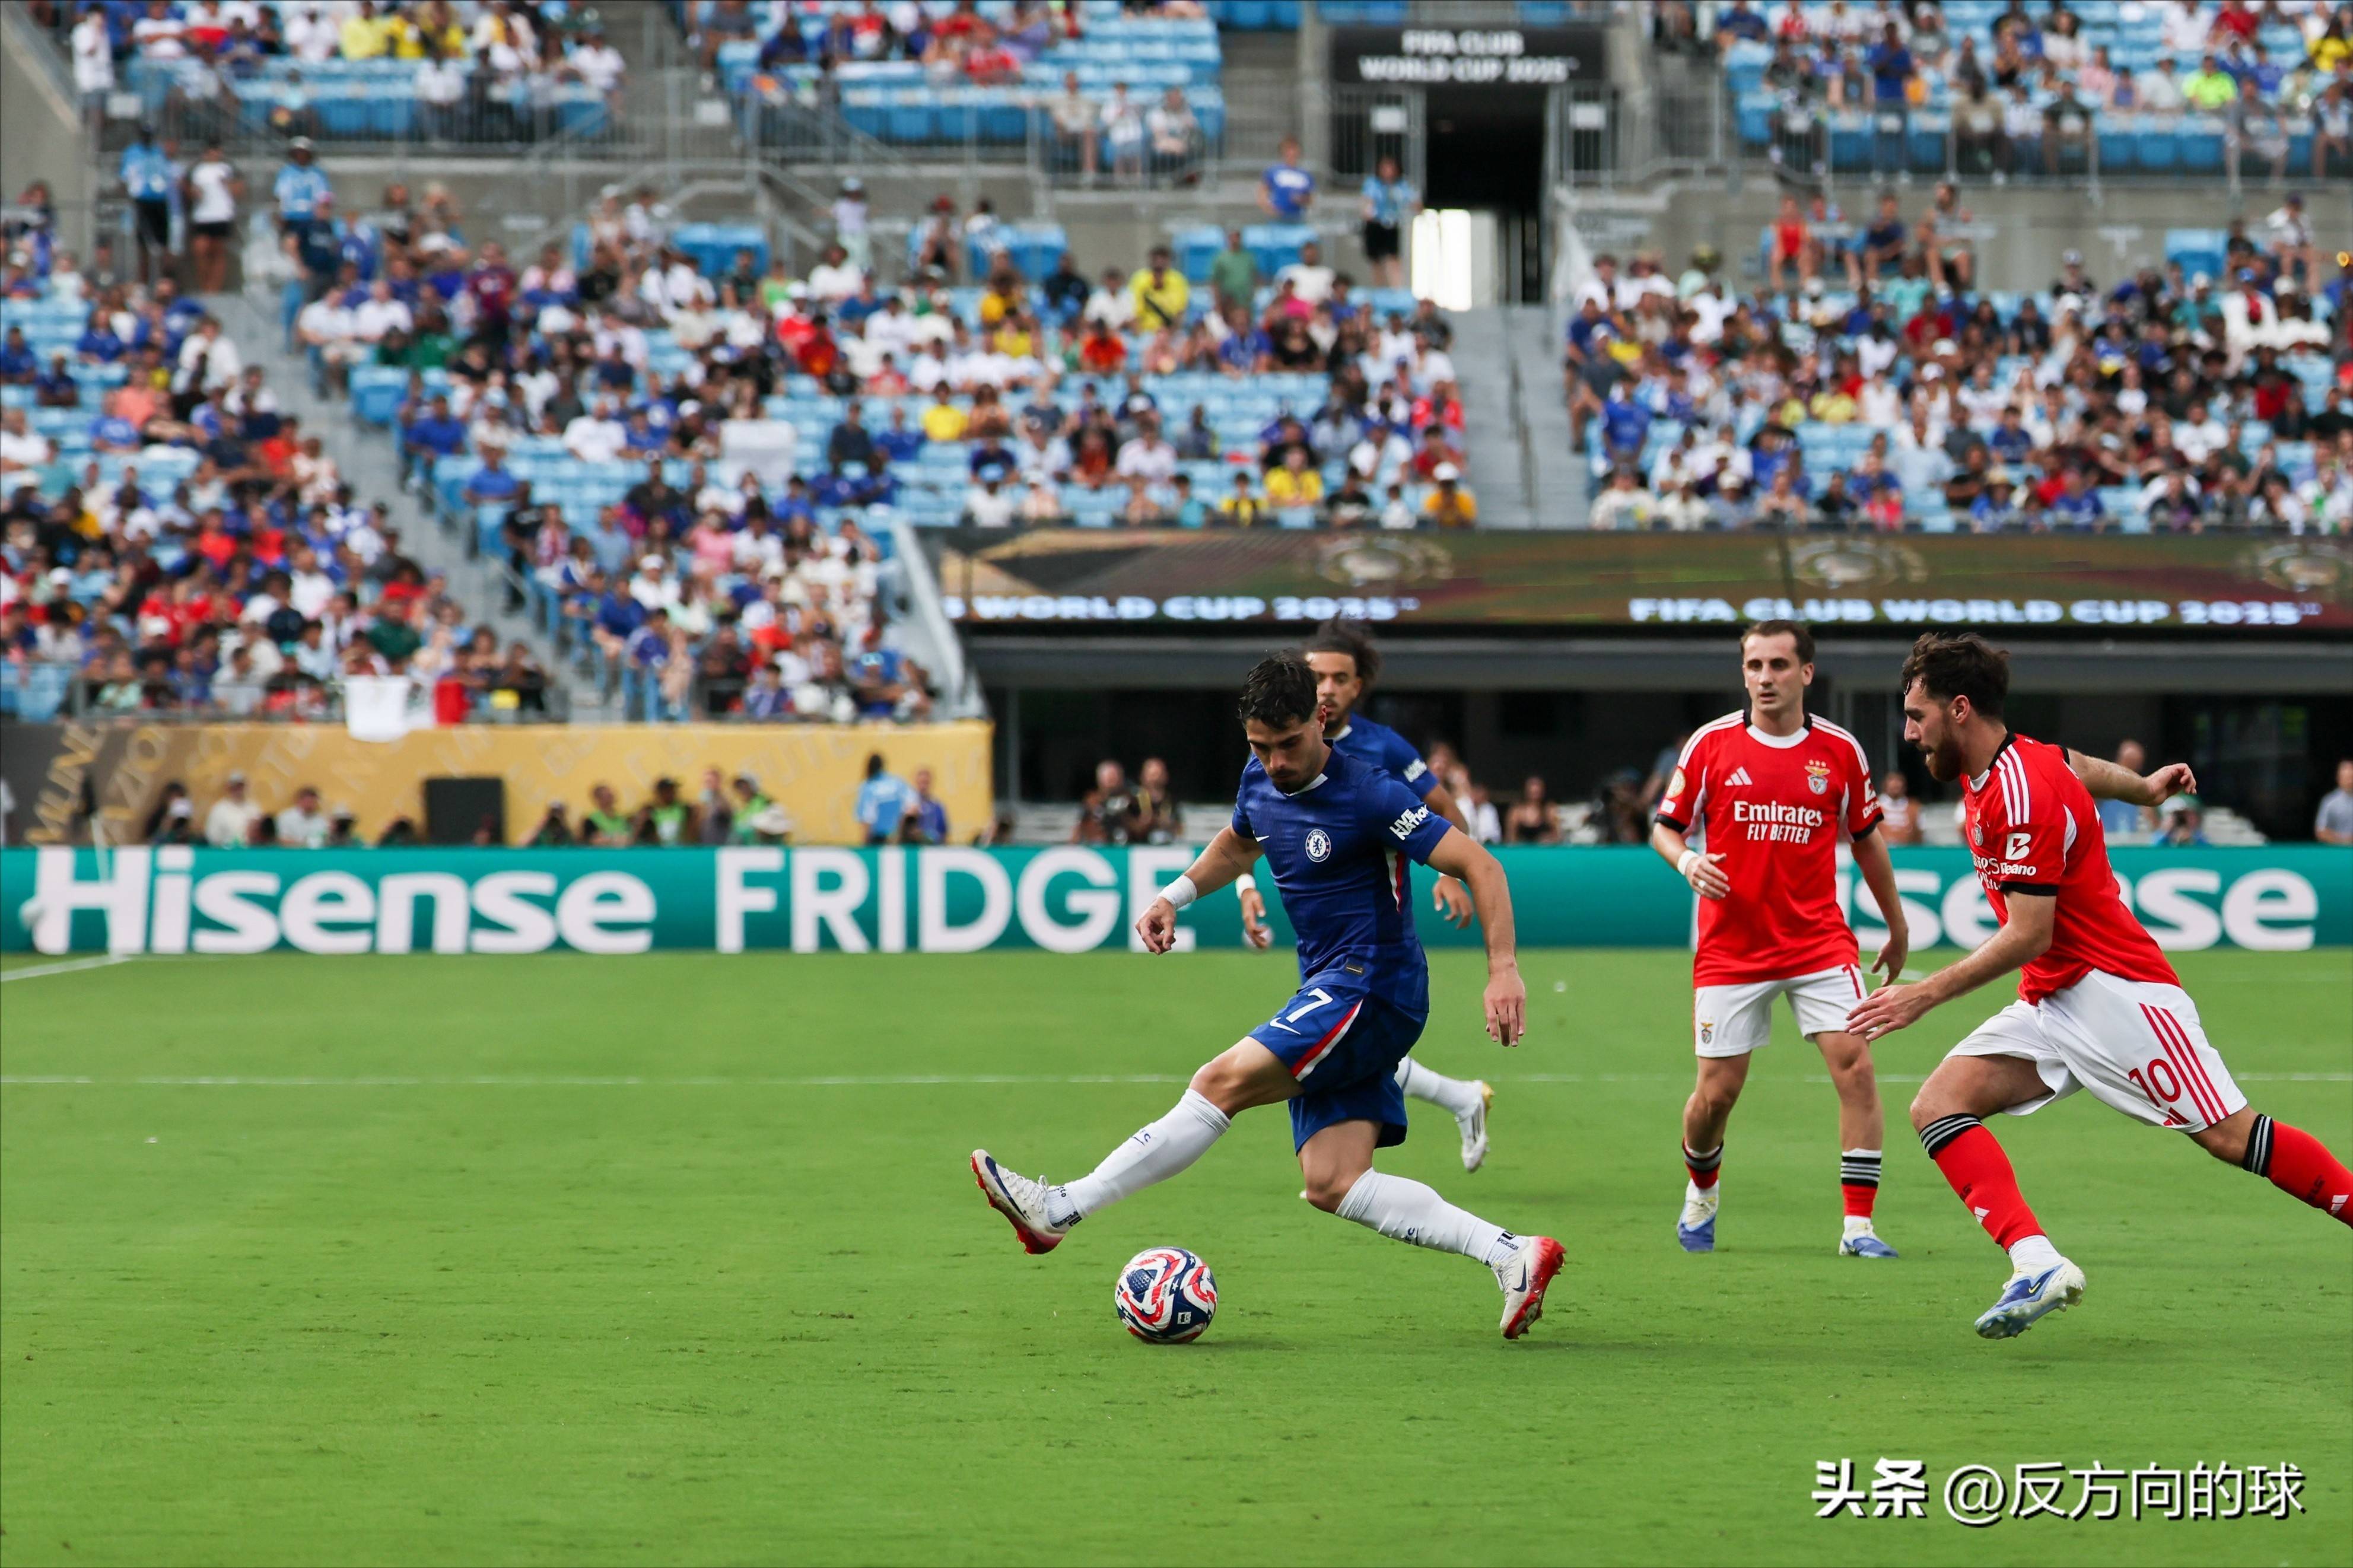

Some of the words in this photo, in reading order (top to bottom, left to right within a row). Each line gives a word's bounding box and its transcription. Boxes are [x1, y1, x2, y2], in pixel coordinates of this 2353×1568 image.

[971, 596, 1156, 619] WORLD
[1162, 596, 1265, 620] CUP
[1629, 597, 1737, 621] FIFA
[1881, 598, 2063, 623] WORLD
[2069, 599, 2171, 624] CUP
[1389, 808, 1417, 835] LIVE
[1734, 800, 1823, 827] Emirates
[1747, 823, 1768, 841] FLY
[1769, 824, 1811, 844] BETTER
[33, 845, 657, 956] Hisense
[714, 847, 1195, 954] FRIDGE
[1307, 987, 1334, 1023] 7
[2128, 1058, 2182, 1108] 10
